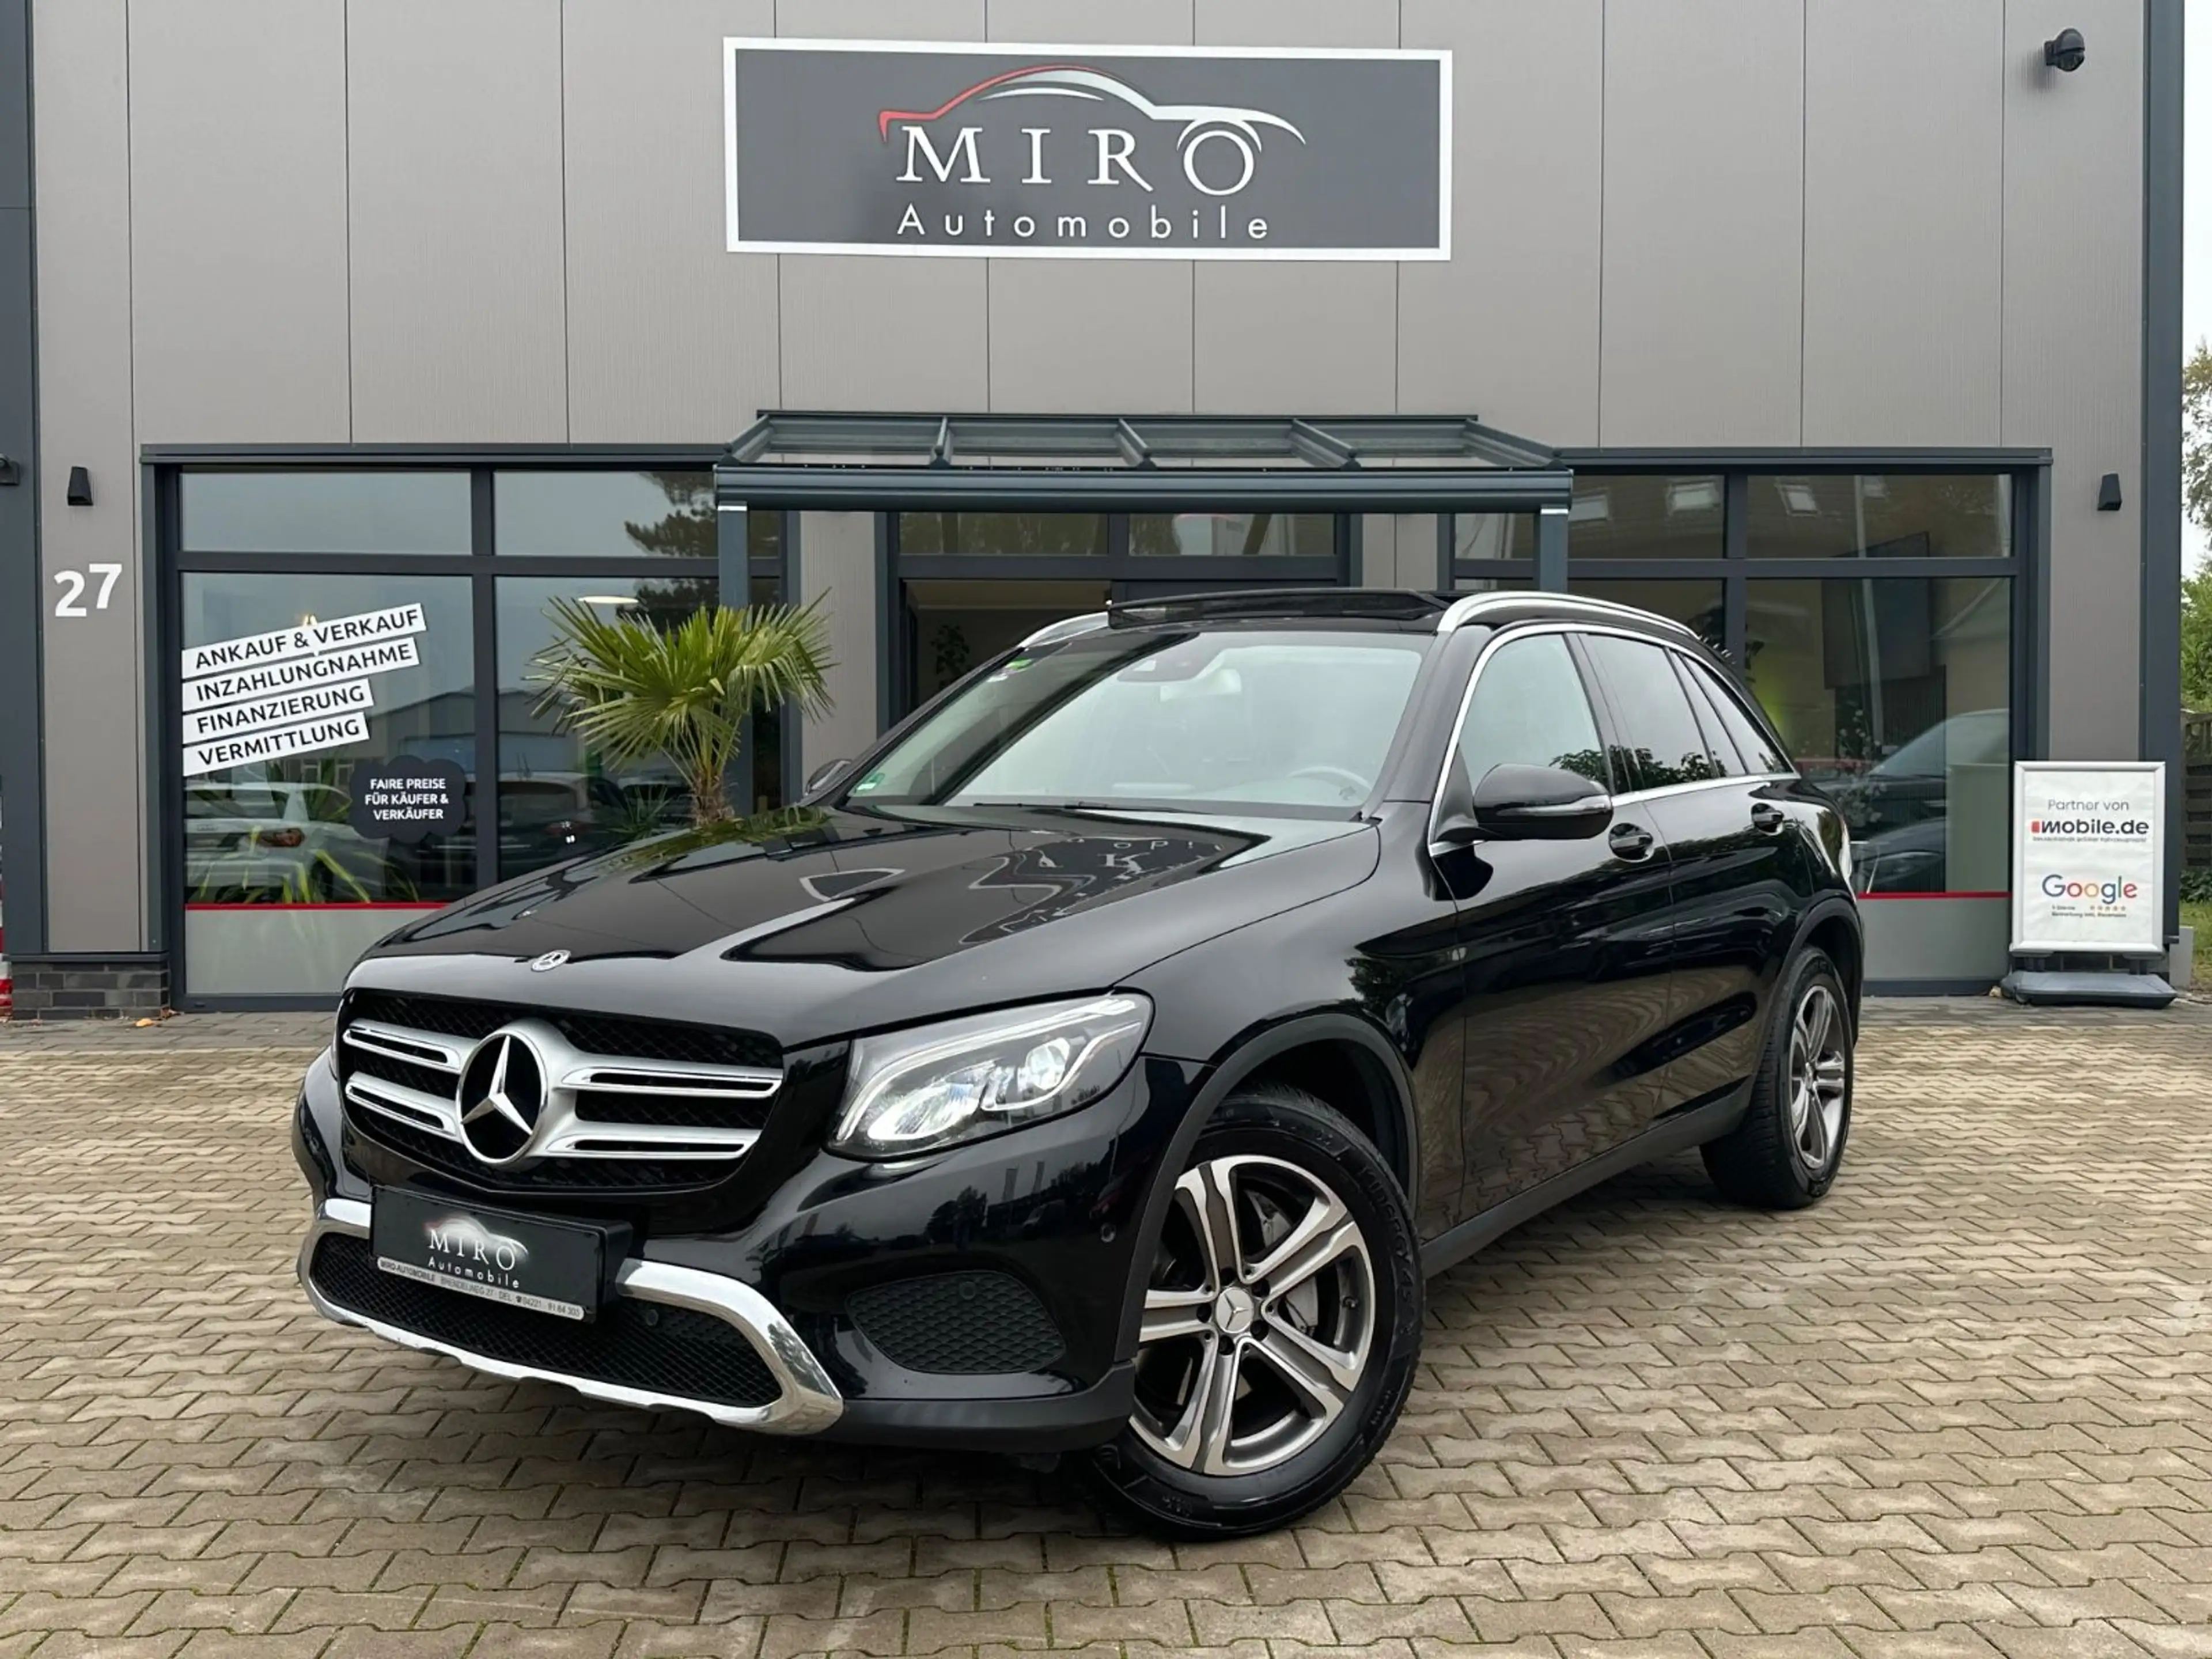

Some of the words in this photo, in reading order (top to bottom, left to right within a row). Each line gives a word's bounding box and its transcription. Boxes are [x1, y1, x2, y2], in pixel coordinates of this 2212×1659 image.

[896, 125, 1255, 196] MIRO
[897, 203, 1269, 239] Automobile
[54, 563, 122, 617] 27
[195, 635, 287, 670] ANKAUF
[294, 631, 309, 649] &
[313, 609, 419, 644] VERKAUF
[196, 643, 412, 702] INZAHLUNGNAHME
[197, 685, 365, 734] FINANZIERUNG
[199, 719, 360, 766] VERMITTLUNG
[365, 793, 389, 805] FÜR
[391, 791, 438, 805] KÄUFER
[441, 794, 449, 804] &
[370, 778, 404, 790] FAIRE
[407, 778, 446, 789] PREISE
[373, 806, 444, 820] VERKÄUFER
[2048, 798, 2100, 812] Partner
[2103, 801, 2129, 811] von
[2041, 819, 2149, 835] mobile.de
[2042, 873, 2138, 904] Google
[429, 1229, 516, 1271] MIRO
[428, 1256, 520, 1289] Automobile
